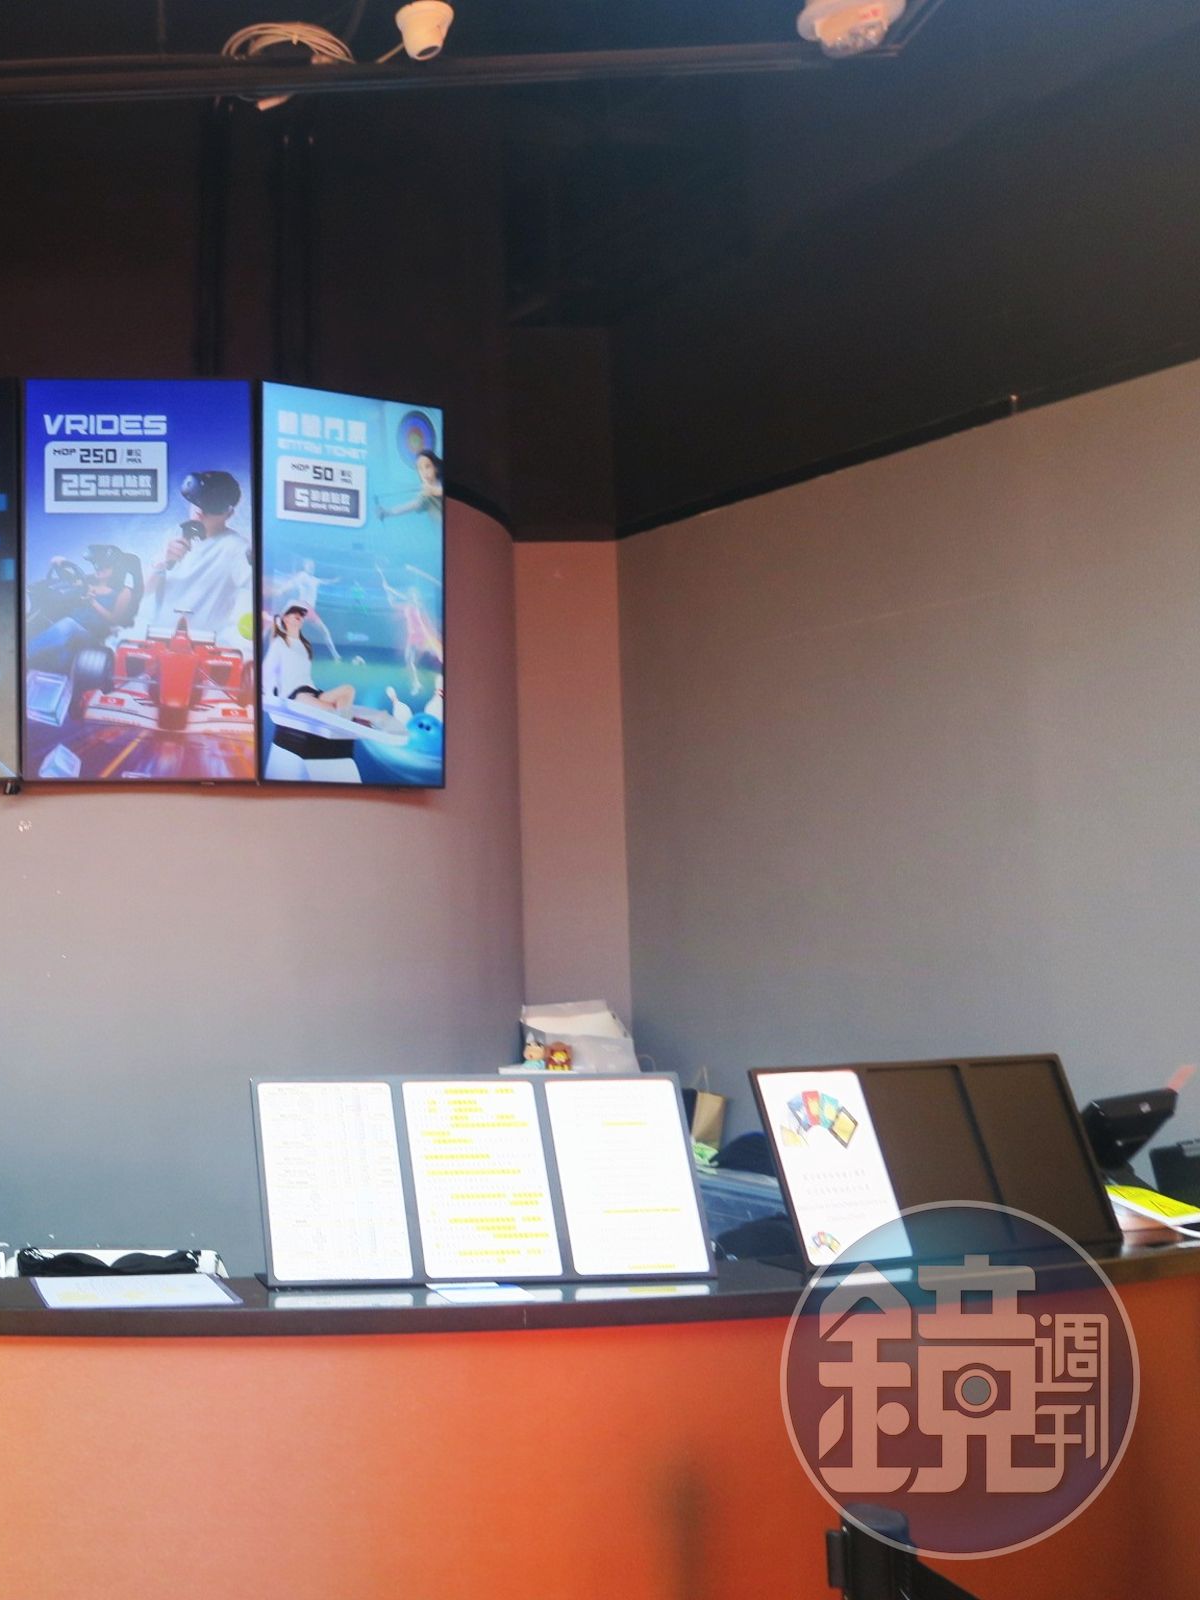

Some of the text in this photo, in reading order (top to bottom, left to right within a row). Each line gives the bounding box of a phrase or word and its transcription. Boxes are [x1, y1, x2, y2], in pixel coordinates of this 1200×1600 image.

[43, 414, 167, 435] VRIDES
[52, 448, 77, 456] MOP
[80, 448, 117, 463] 250
[313, 465, 333, 481] 50
[61, 474, 97, 496] 25
[294, 487, 310, 507] 5
